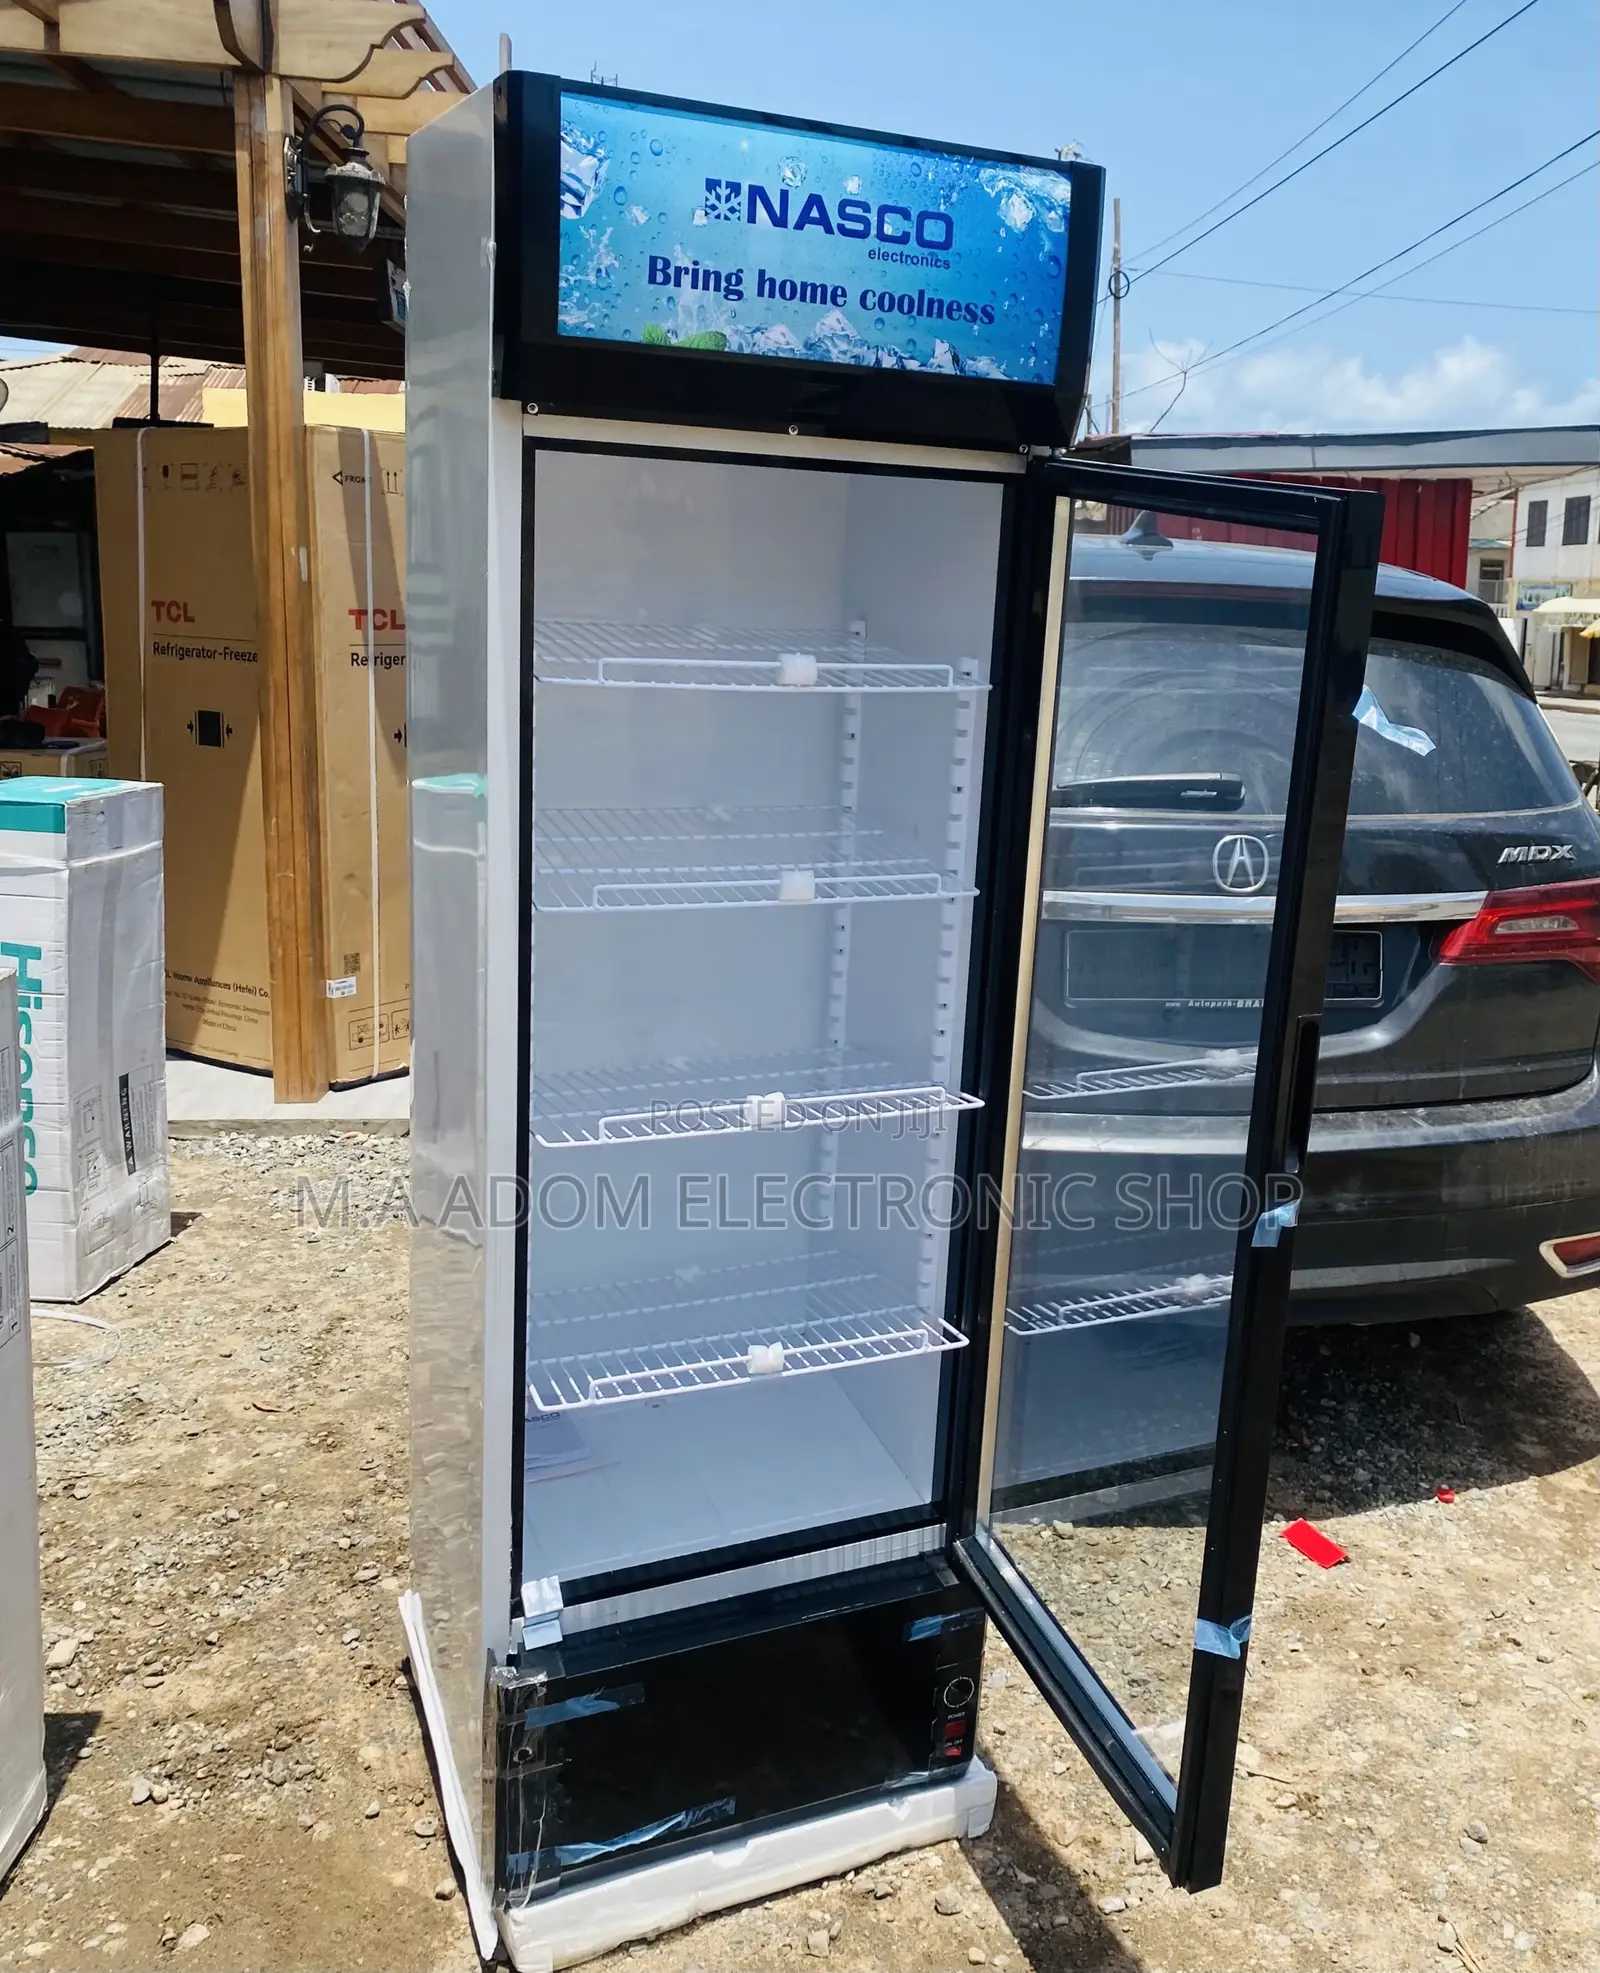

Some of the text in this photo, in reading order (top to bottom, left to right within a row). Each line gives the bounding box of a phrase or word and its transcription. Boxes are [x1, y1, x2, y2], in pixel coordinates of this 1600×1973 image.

[746, 184, 954, 251] NASCO
[868, 247, 951, 270] electronics
[648, 255, 996, 325] Bring home coolness
[151, 600, 195, 623] TCL
[348, 609, 406, 631] TCL
[351, 652, 406, 670] Reriger
[1498, 844, 1577, 864] MDX
[233, 982, 257, 997] (Hefei)
[121, 1086, 133, 1152] WARNING
